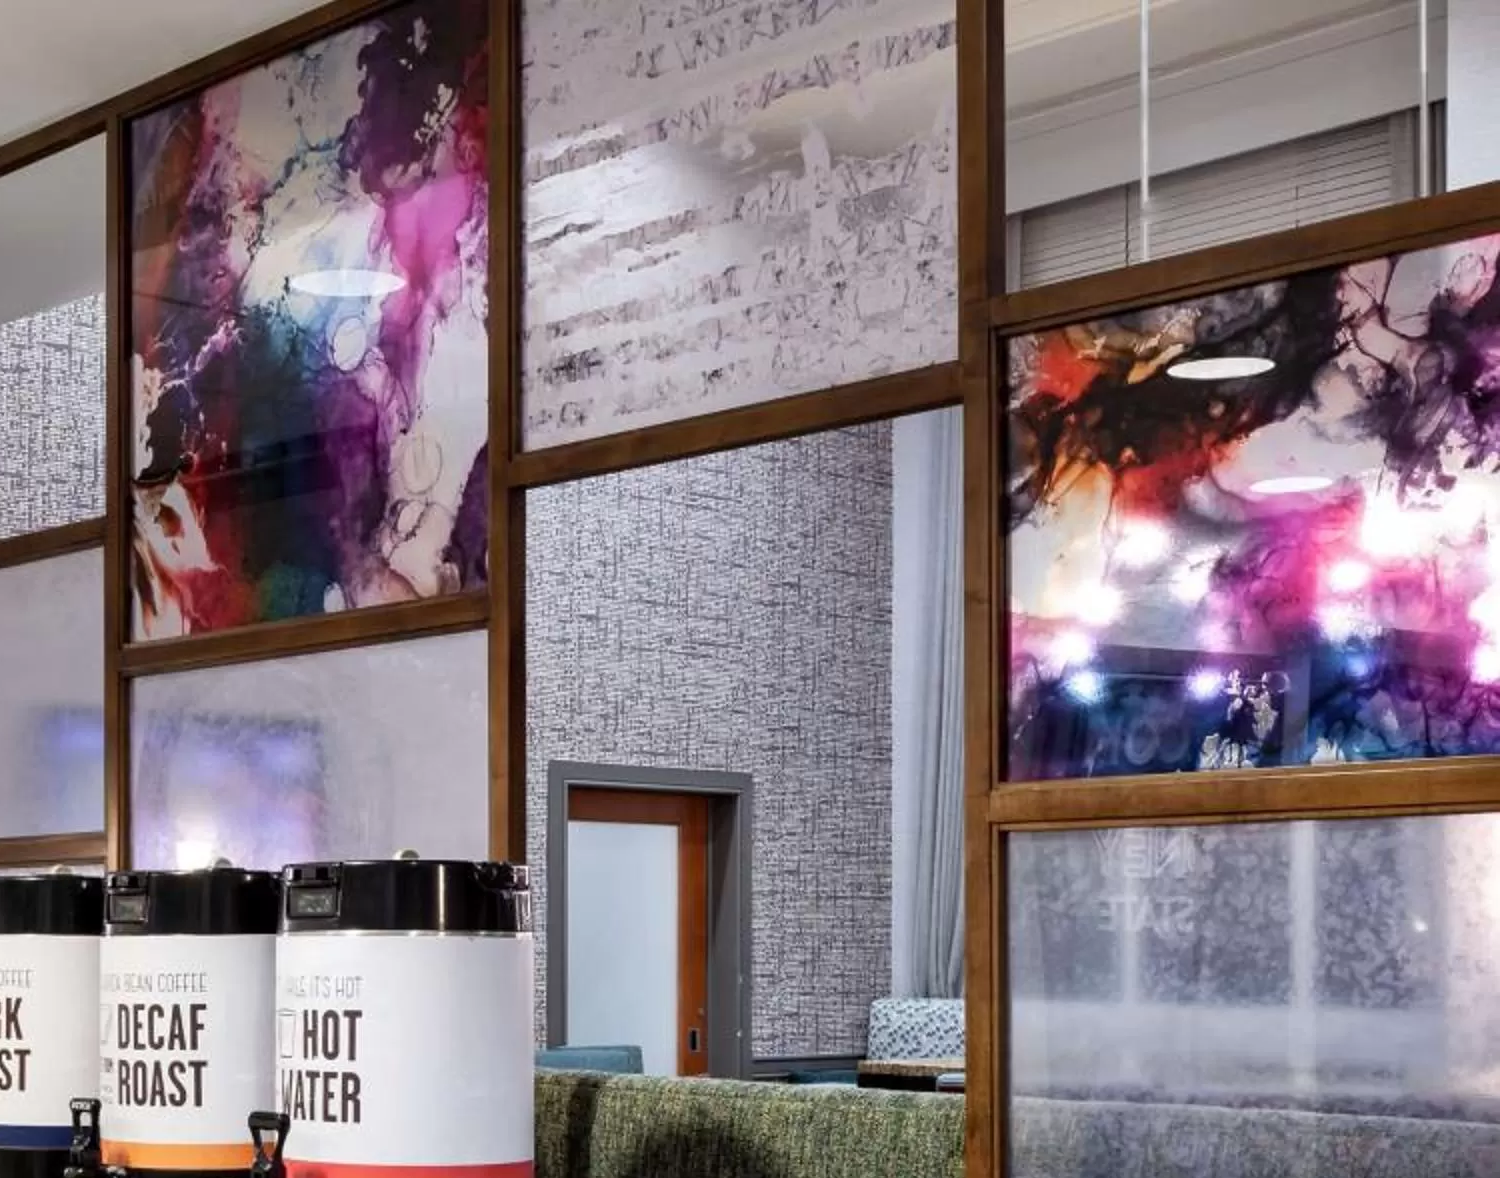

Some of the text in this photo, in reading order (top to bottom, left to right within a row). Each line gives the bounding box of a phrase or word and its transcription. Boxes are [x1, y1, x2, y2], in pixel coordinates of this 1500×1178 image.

[157, 972, 208, 993] COFFEE
[335, 975, 364, 999] HOT
[117, 1003, 207, 1051] DECAF
[303, 1009, 363, 1061] HOT
[117, 1058, 208, 1108] ROAST
[281, 1069, 361, 1124] WATER
